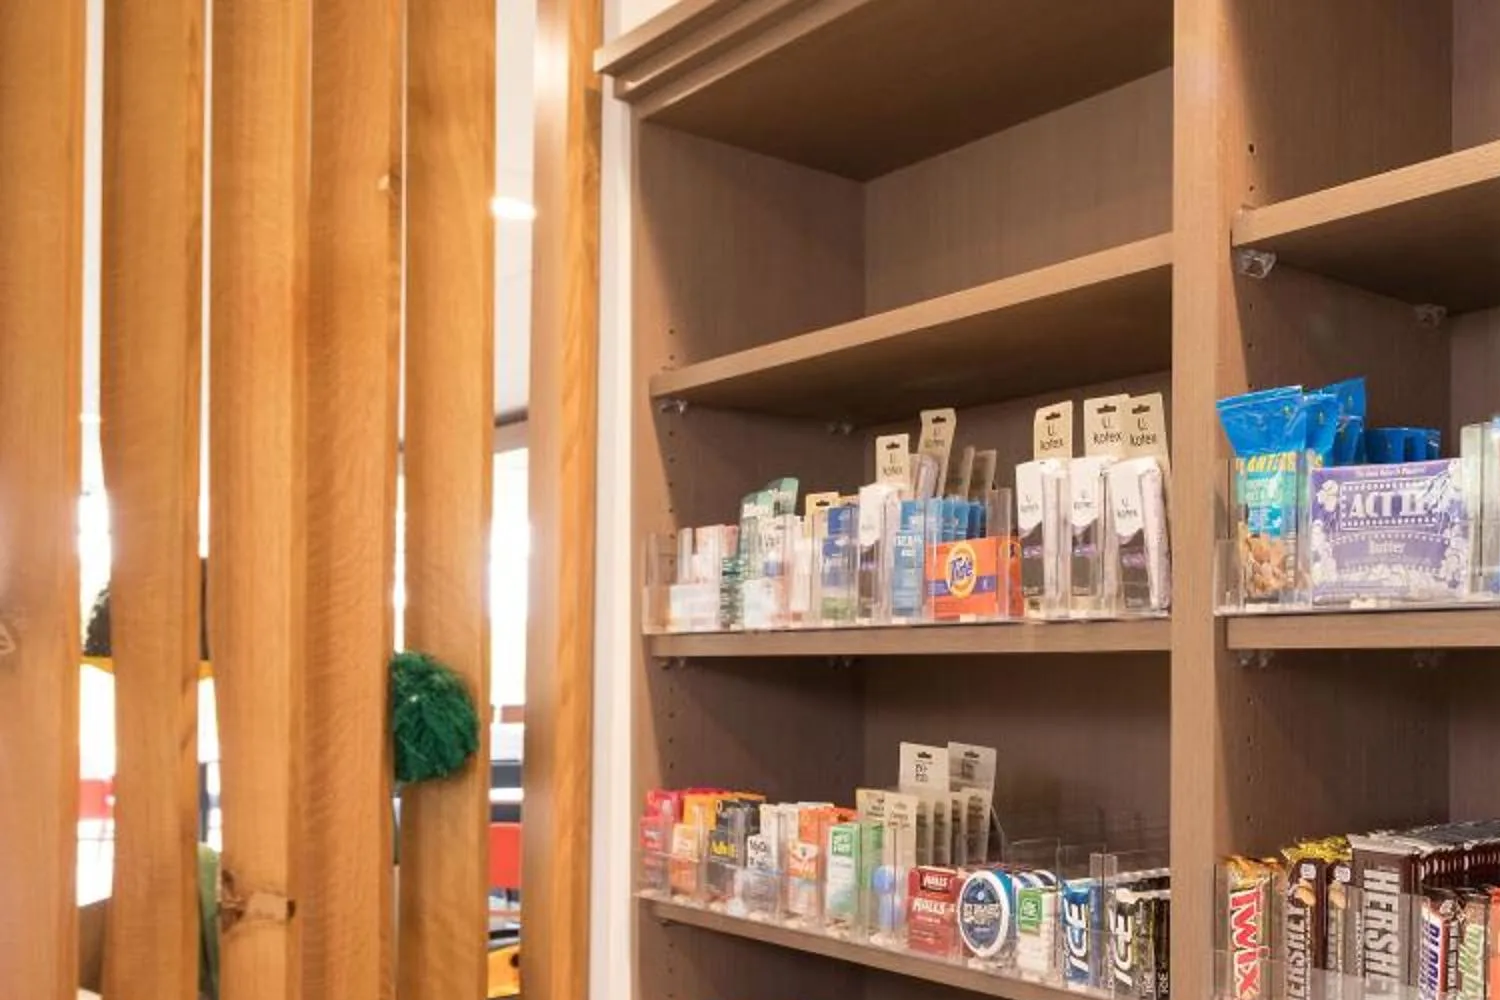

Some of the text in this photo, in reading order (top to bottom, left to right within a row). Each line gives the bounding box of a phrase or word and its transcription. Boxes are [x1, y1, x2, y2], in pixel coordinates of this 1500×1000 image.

[1350, 490, 1393, 518] ACT
[1064, 897, 1089, 973] ICE
[1109, 908, 1133, 987] ICE
[1229, 886, 1262, 999] TWIX
